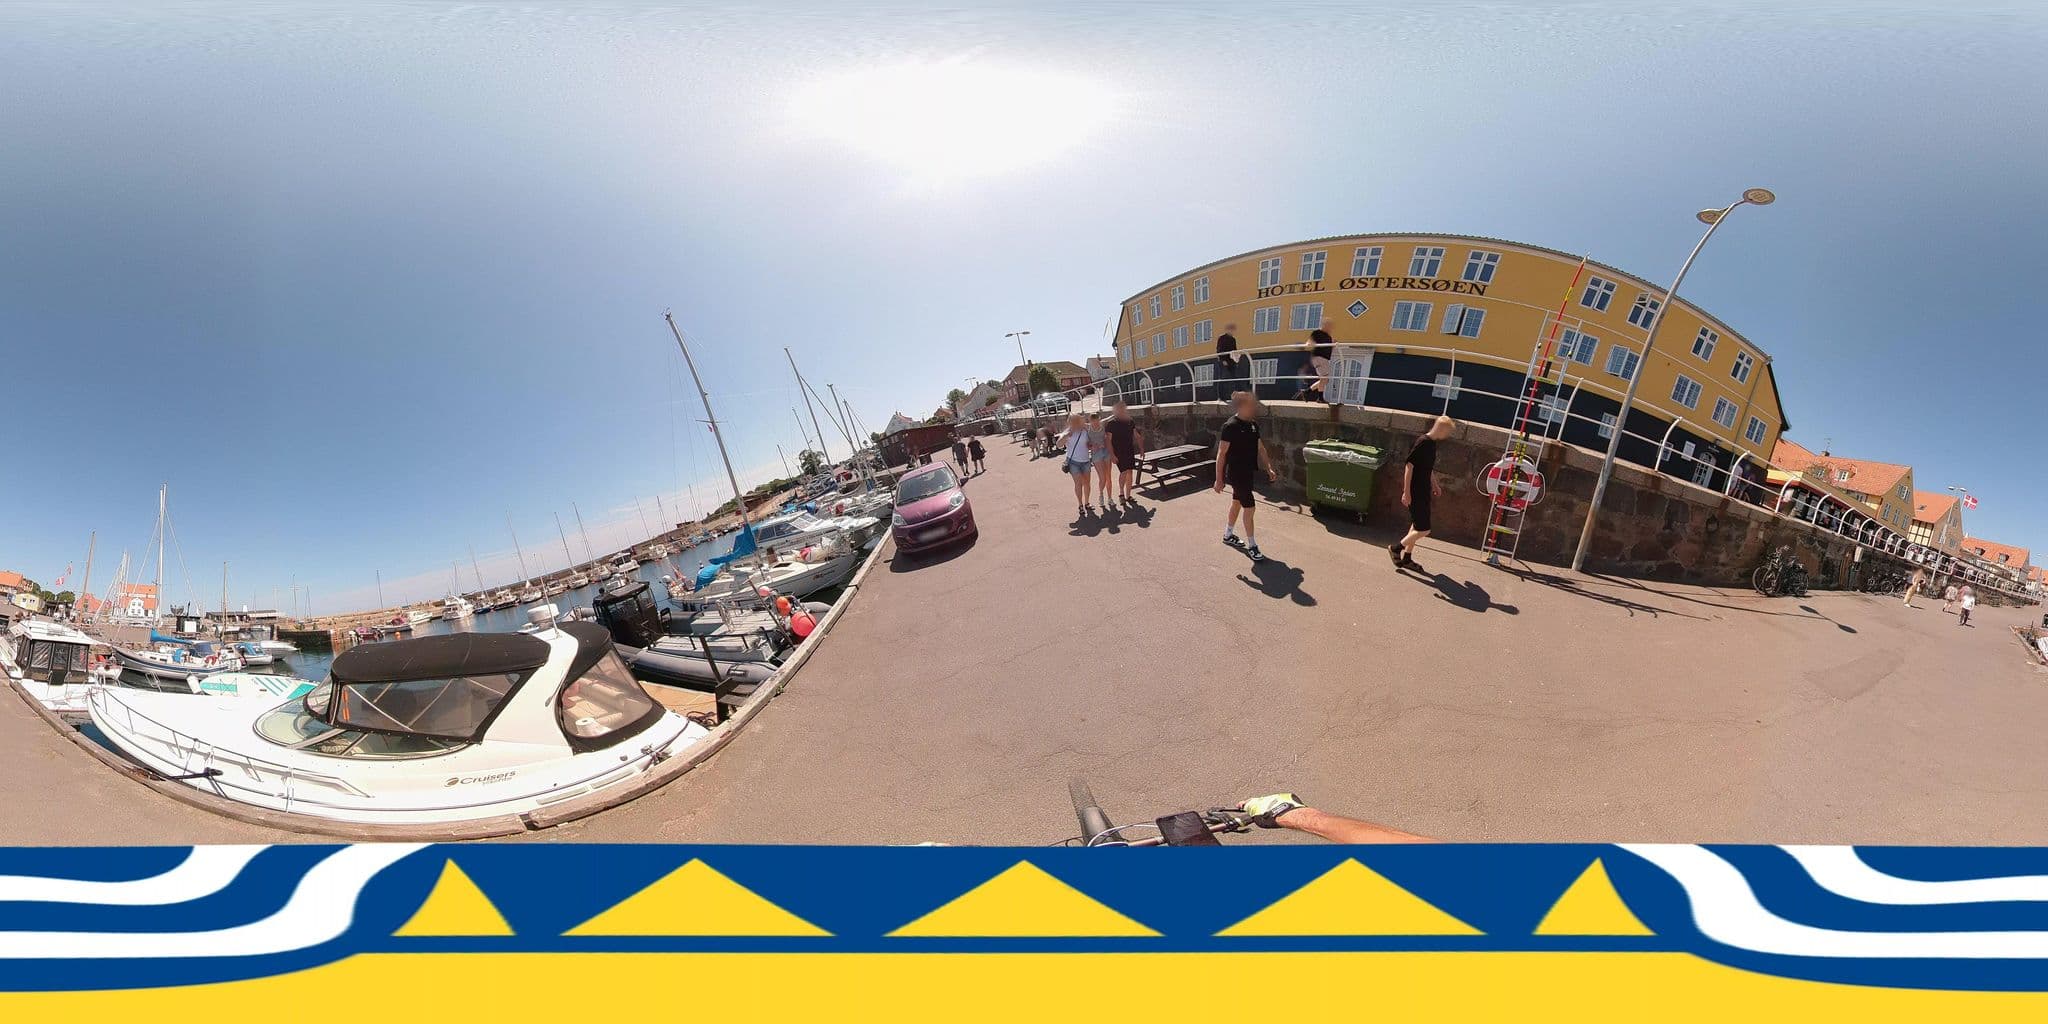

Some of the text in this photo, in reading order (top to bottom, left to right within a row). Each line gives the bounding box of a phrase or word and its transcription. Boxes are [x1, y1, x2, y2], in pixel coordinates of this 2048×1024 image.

[1257, 277, 1488, 299] HOTEL ØSTERSØEN
[460, 771, 516, 785] Cruisers
